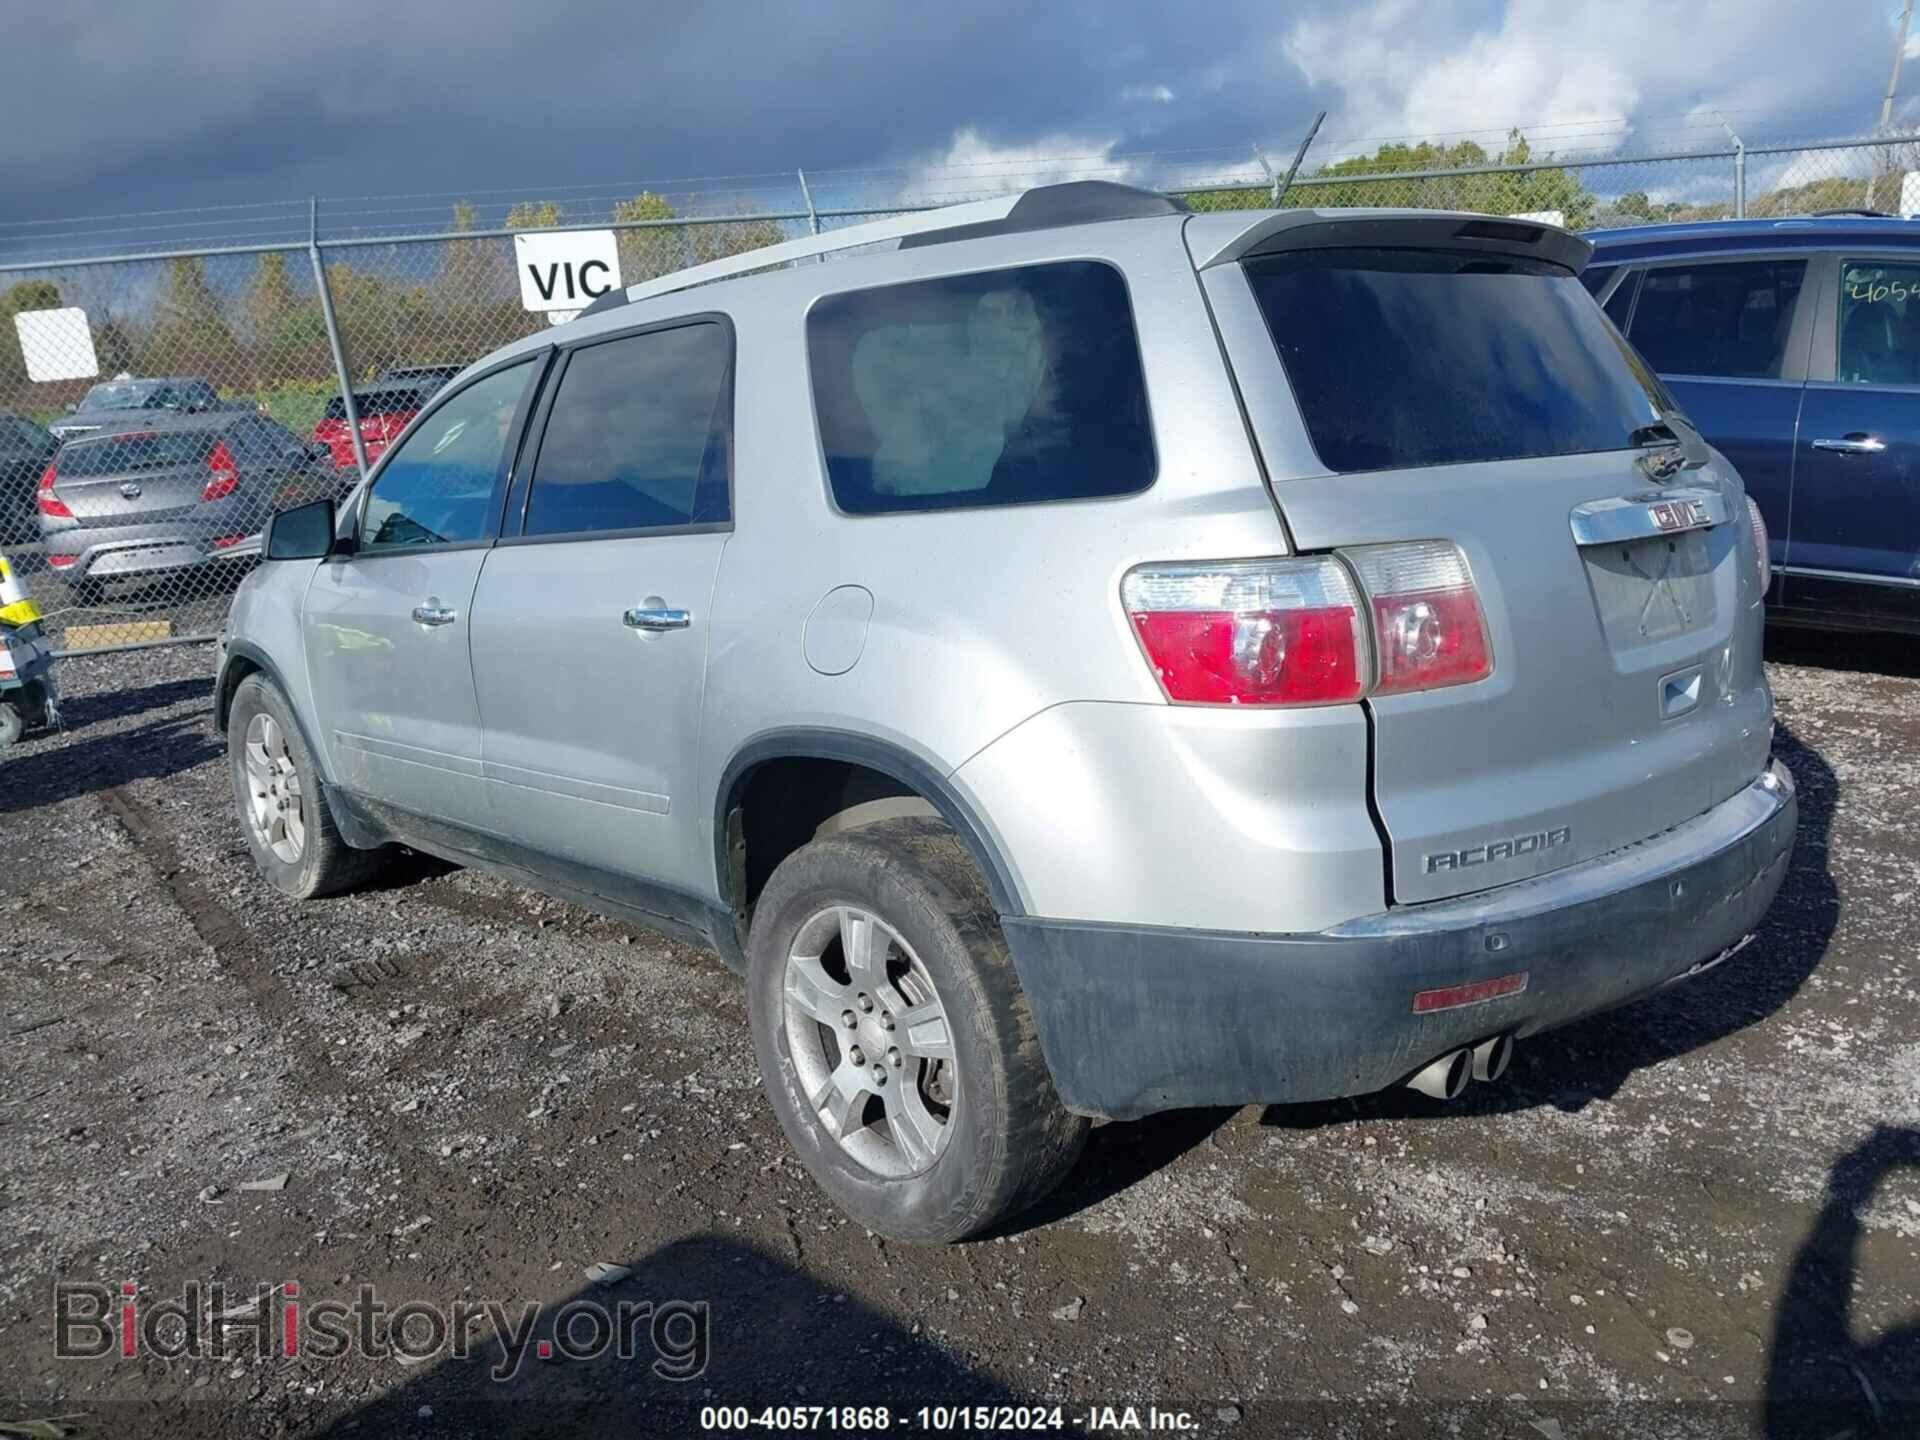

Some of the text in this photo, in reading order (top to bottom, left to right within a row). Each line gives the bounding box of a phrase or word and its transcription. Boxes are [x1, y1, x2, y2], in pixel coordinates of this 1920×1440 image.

[528, 260, 612, 300] VIC
[1648, 500, 1711, 532] GMC
[1422, 825, 1571, 874] ACADIA
